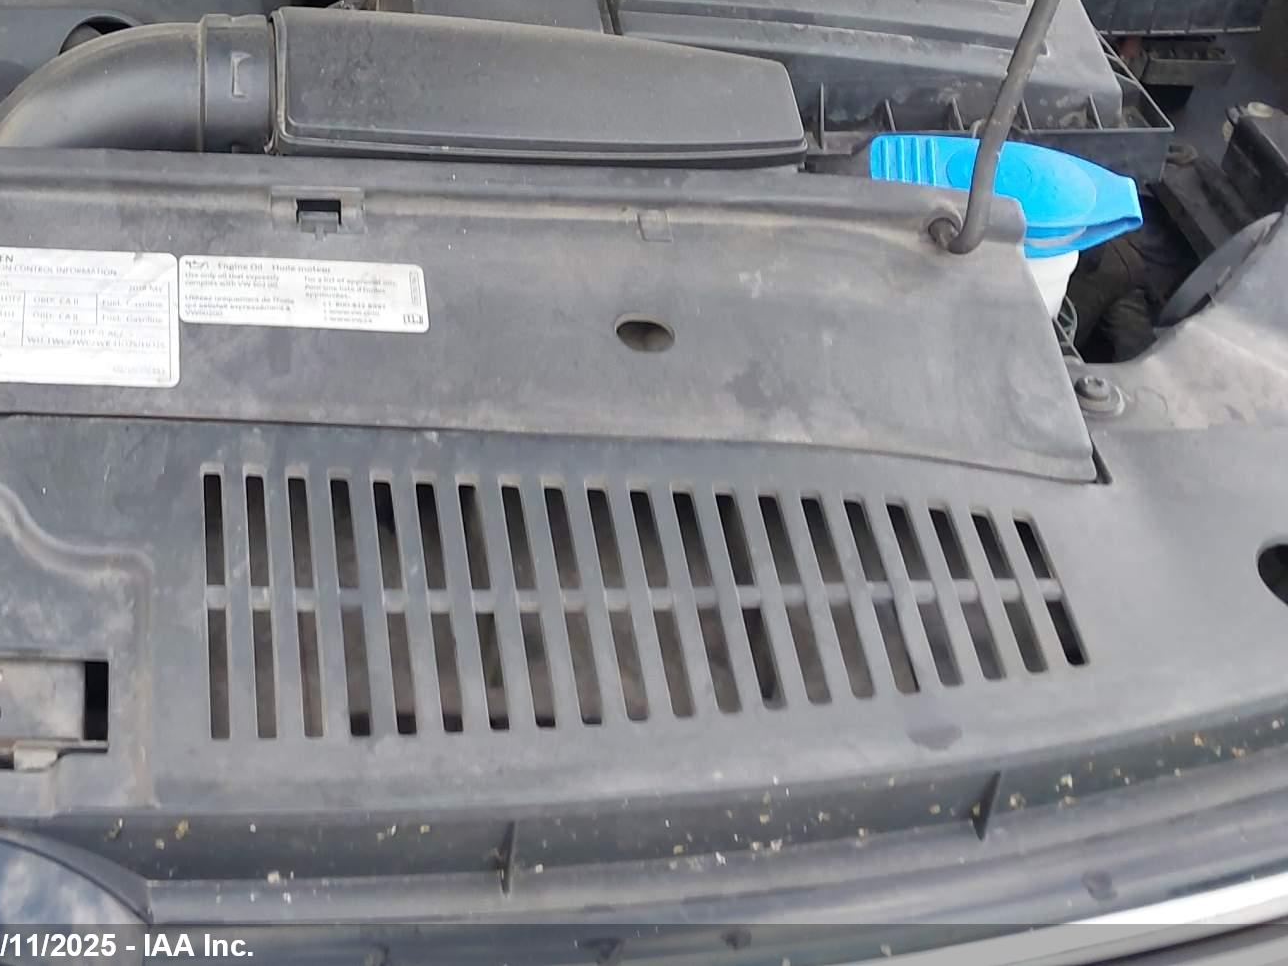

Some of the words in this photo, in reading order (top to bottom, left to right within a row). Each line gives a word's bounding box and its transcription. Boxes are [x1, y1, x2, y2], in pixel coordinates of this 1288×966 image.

[14, 266, 53, 274] CONTROL
[56, 267, 117, 276] INFORMATION
[218, 262, 248, 272] Engine
[250, 263, 262, 271] Oil
